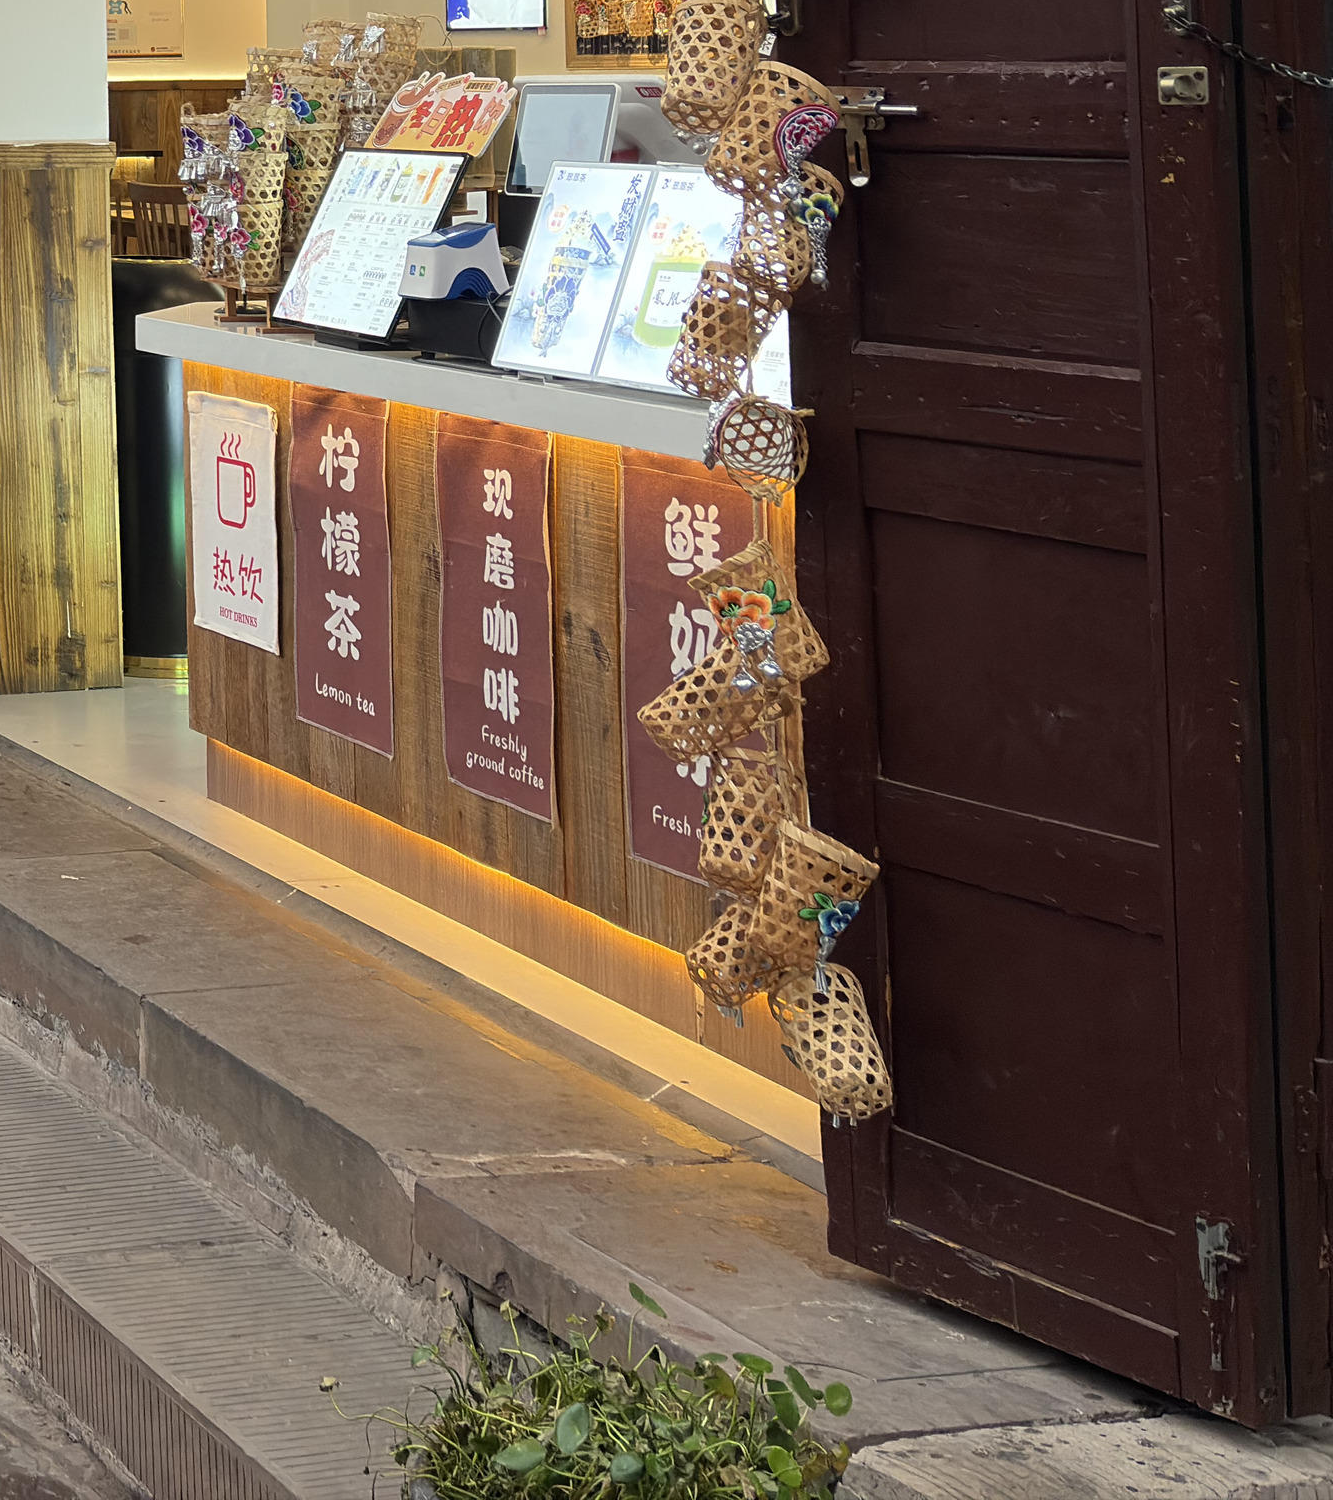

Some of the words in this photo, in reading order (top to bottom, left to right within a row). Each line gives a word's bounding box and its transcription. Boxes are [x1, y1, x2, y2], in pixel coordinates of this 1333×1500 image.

[409, 93, 506, 148] 冬日热饮
[319, 423, 362, 661] 柠檬茶
[213, 546, 264, 605] 热饮
[482, 468, 521, 725] 现磨咖啡
[219, 605, 234, 621] HOT
[233, 610, 259, 629] DRINKS
[664, 497, 722, 788] 鲜奶
[315, 672, 352, 707] Lemon
[356, 692, 376, 717] tea
[481, 724, 528, 763] Freshly
[465, 750, 505, 777] ground
[509, 764, 545, 791] coffee
[652, 805, 691, 838] Fresh
